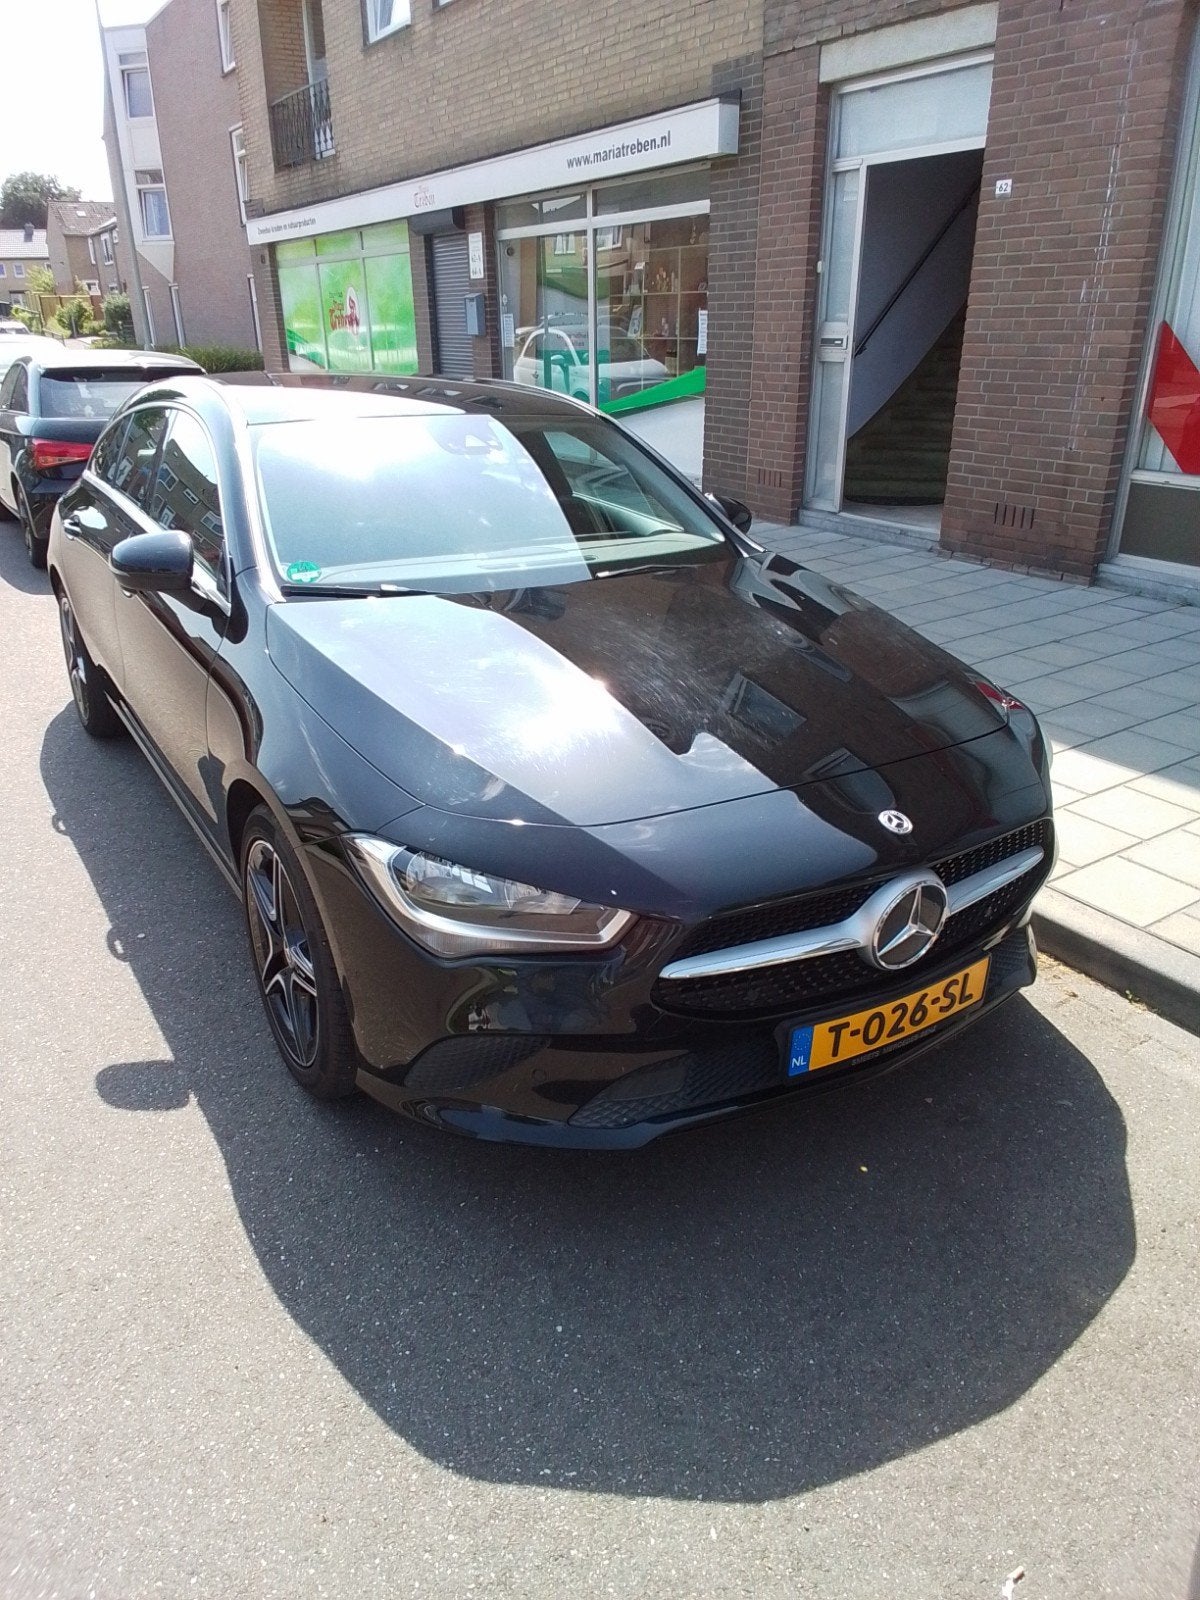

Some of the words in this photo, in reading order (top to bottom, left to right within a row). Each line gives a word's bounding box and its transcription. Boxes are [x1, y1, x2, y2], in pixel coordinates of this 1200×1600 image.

[566, 130, 672, 169] www.mariatreben.nl
[998, 182, 1009, 193] 62
[828, 972, 974, 1058] T-026-SL
[791, 1055, 807, 1069] NL
